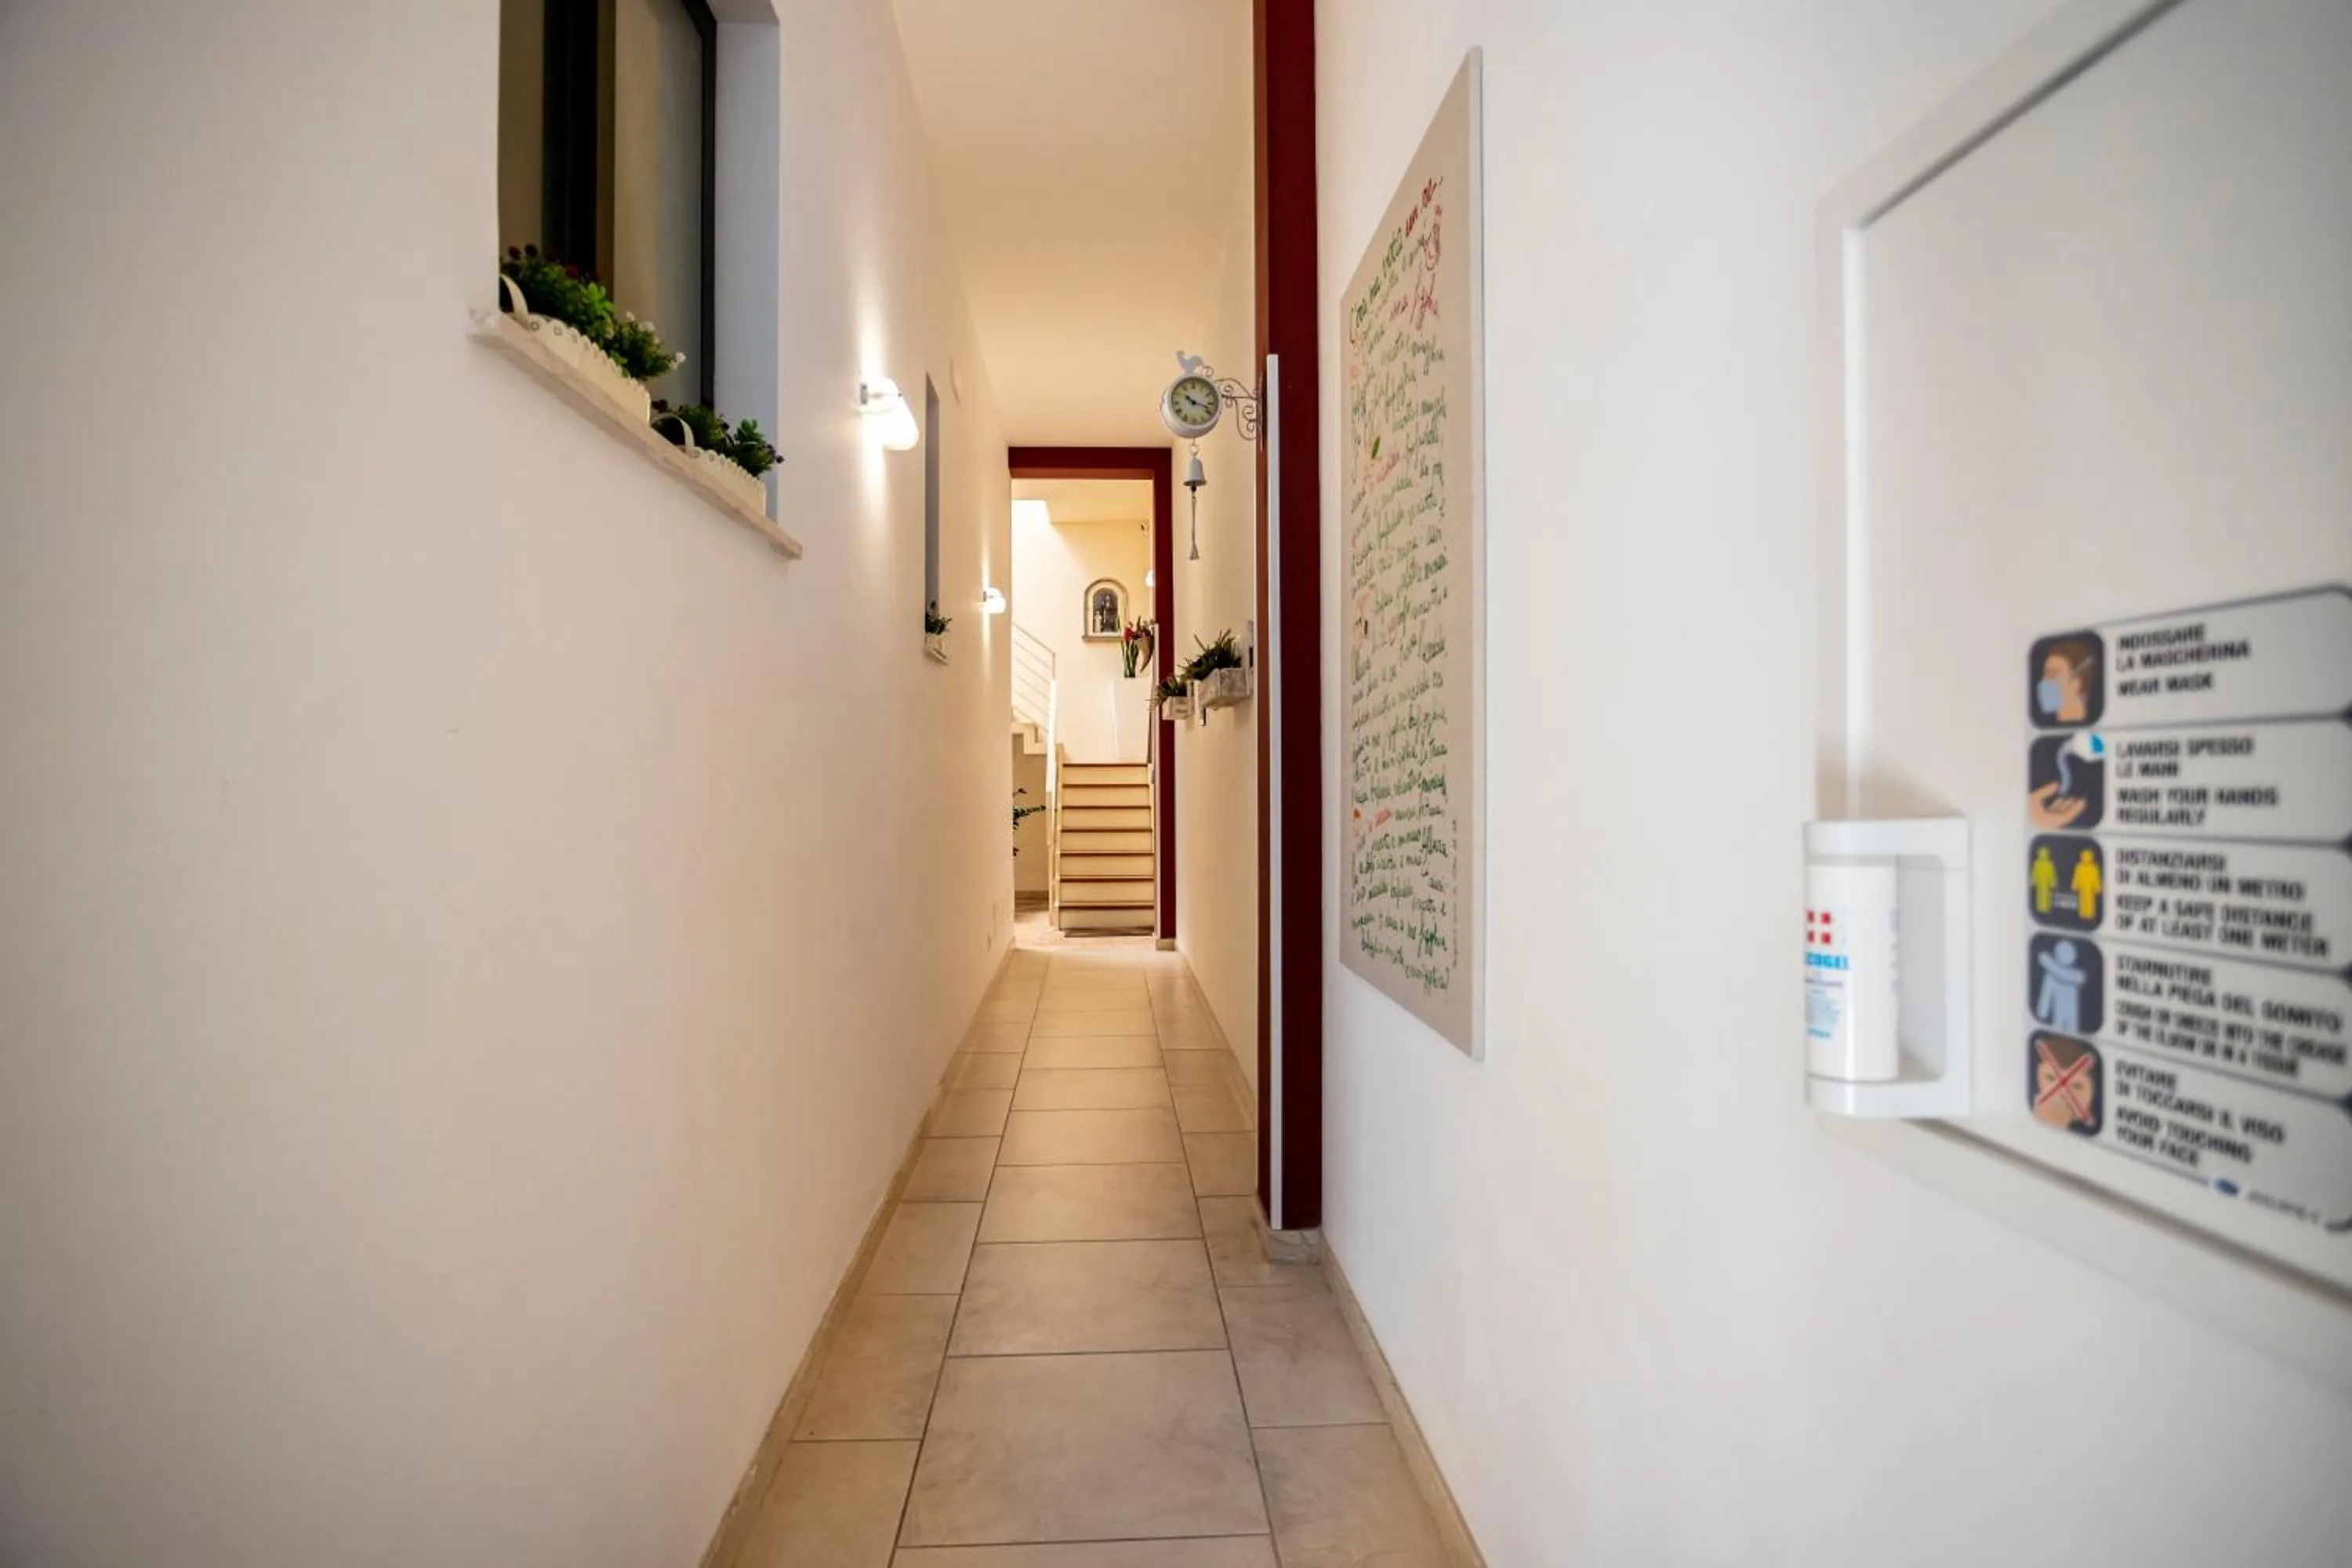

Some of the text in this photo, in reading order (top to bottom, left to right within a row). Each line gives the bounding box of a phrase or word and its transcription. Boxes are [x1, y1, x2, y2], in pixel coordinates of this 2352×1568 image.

[2118, 624, 2205, 651] NDOSSARE
[2140, 639, 2251, 667] MASCHERINA
[2118, 672, 2212, 695] WEAR MASK
[2187, 738, 2254, 757] SPESSO
[2138, 760, 2179, 777] MANI
[2118, 786, 2278, 807] WASH YOUR HANDS
